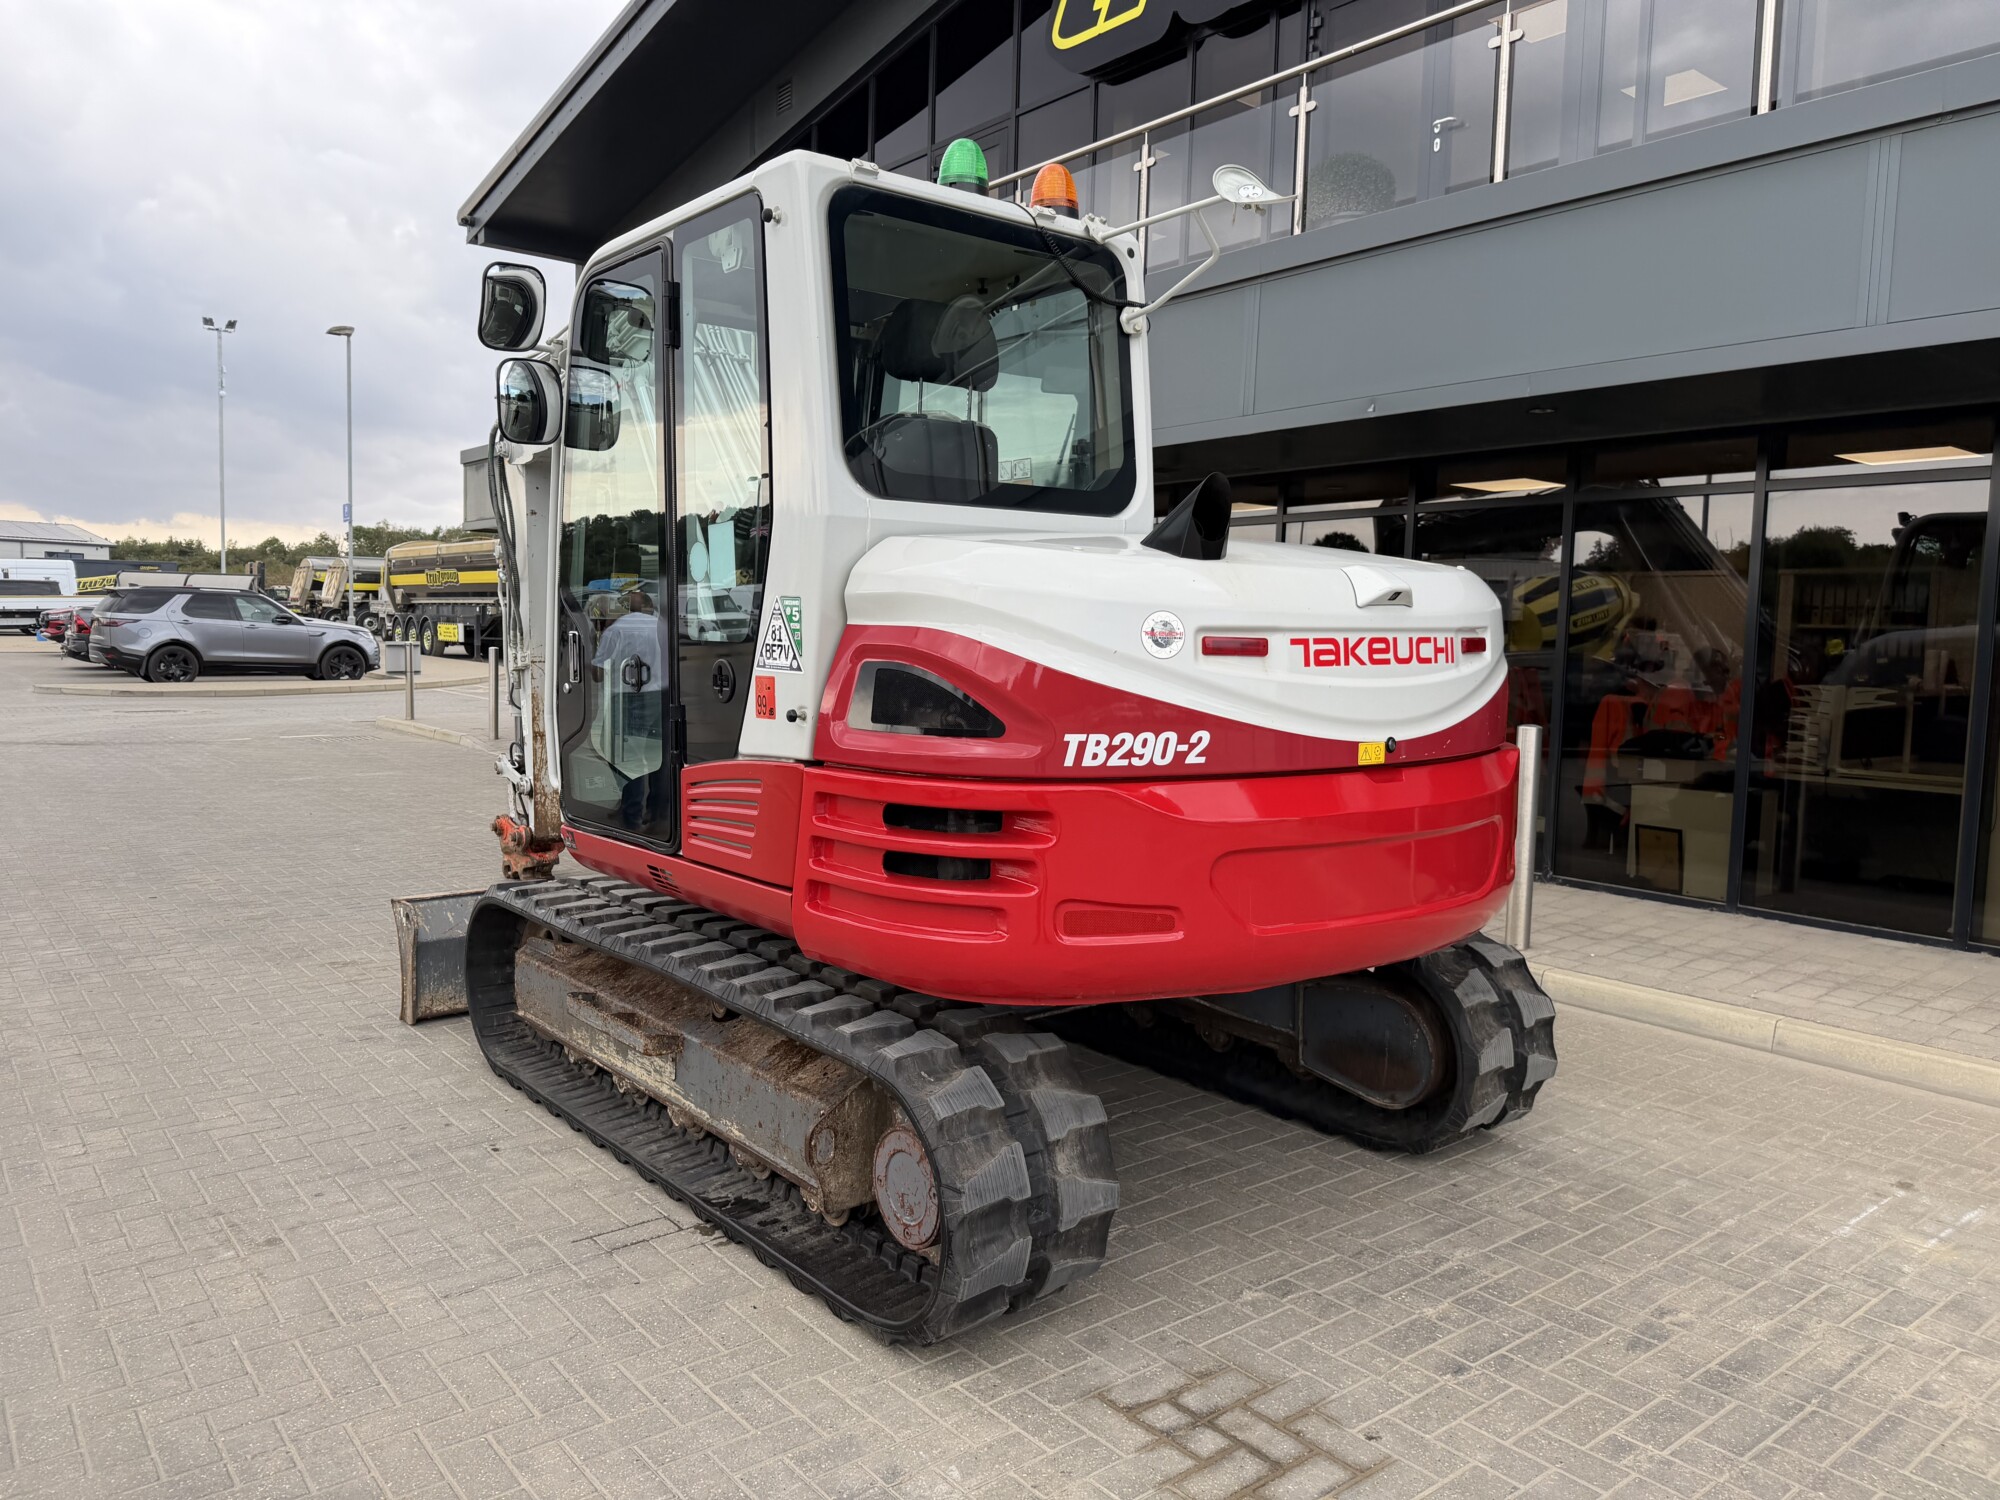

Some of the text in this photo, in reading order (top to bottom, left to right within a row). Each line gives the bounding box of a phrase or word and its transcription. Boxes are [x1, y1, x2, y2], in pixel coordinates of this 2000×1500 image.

[765, 643, 791, 661] BE7V
[1290, 636, 1455, 668] TAKEUCHI
[757, 694, 768, 716] 99
[1063, 730, 1212, 767] TB290-2
